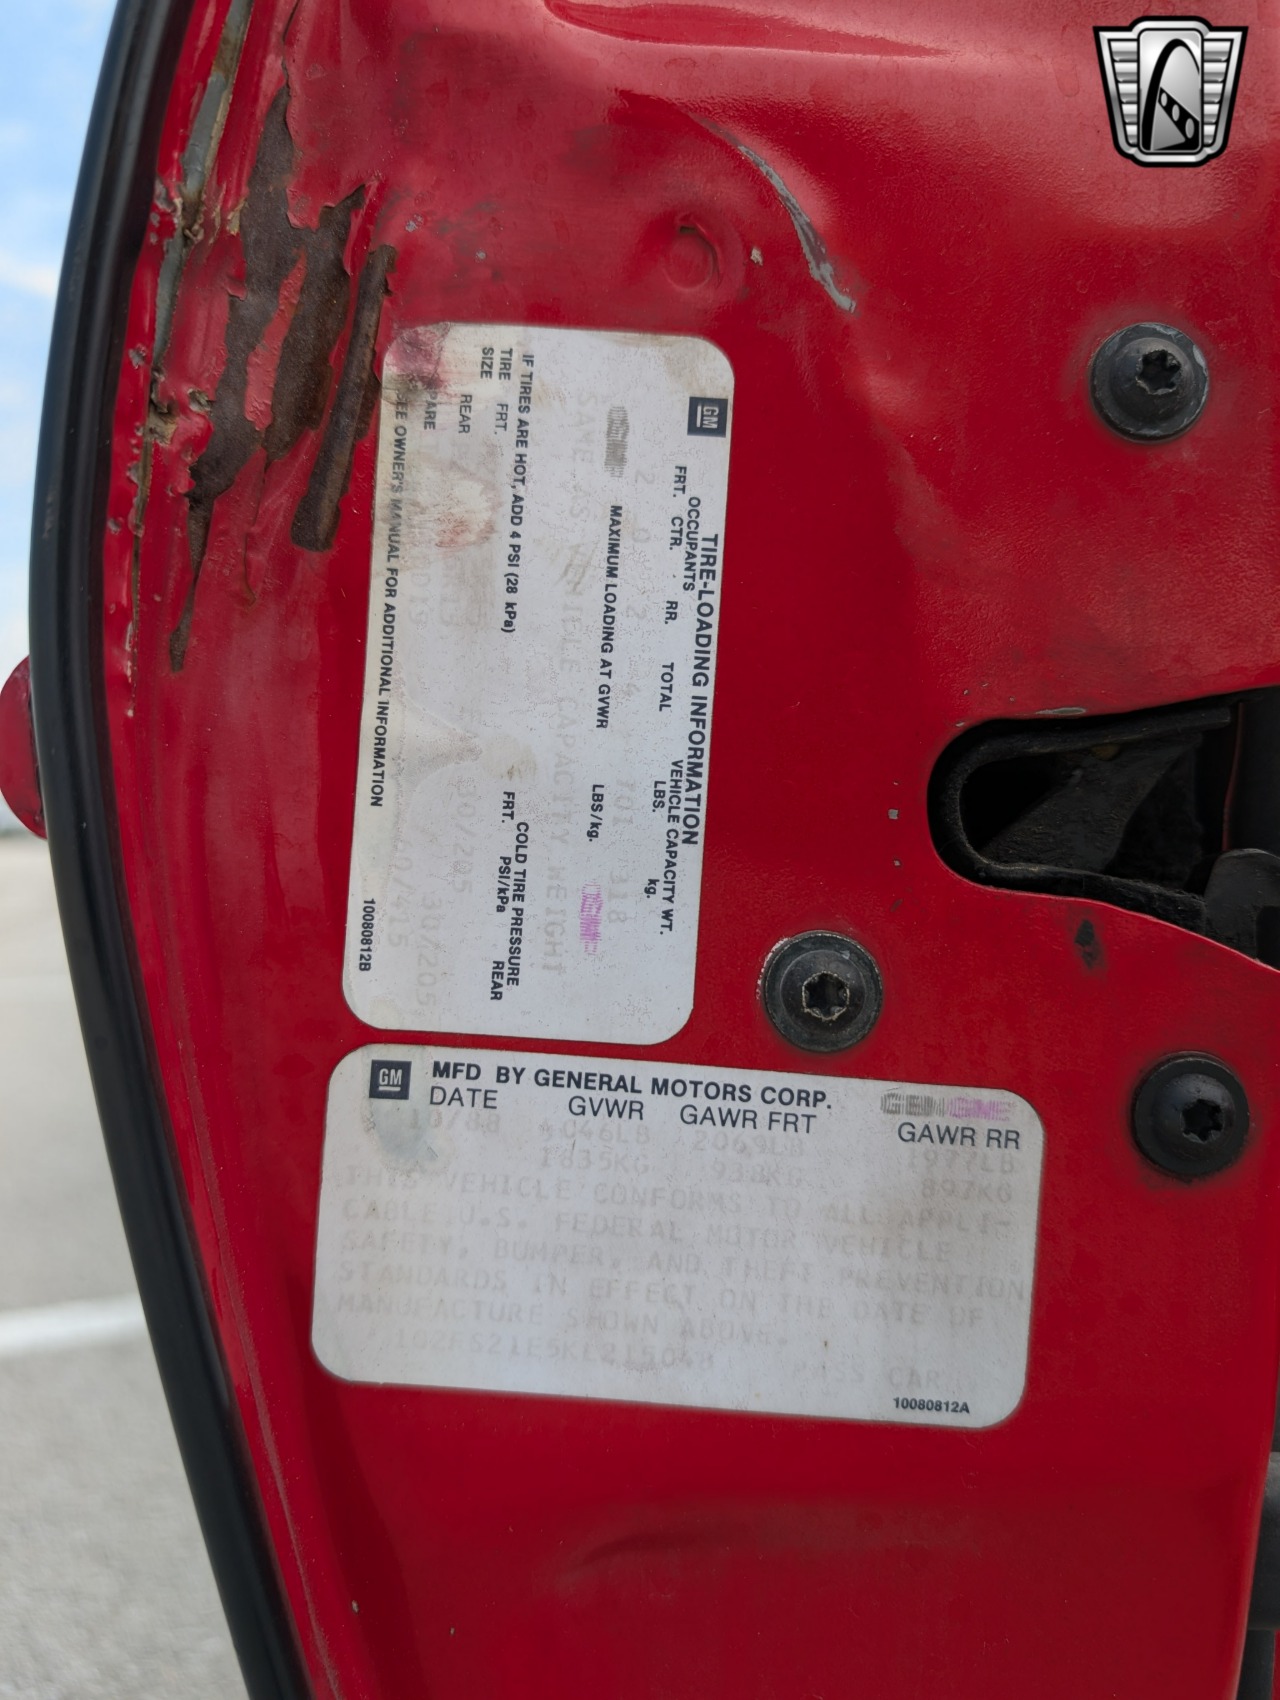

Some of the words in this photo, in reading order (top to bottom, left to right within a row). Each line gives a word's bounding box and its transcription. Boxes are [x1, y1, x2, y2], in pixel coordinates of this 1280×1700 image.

[480, 347, 494, 378] SIZE
[499, 348, 513, 380] TIRE
[522, 354, 534, 367] IF
[518, 372, 532, 413] TIRES
[459, 394, 472, 433] REAR
[495, 403, 508, 434] FRT.
[516, 418, 529, 448] ARE
[391, 426, 407, 493] OWNER'S
[511, 454, 527, 489] HOT,
[673, 466, 687, 497] FRT.
[511, 494, 524, 526] ADD
[510, 531, 521, 539] 4
[606, 506, 622, 578] MAXIMUM
[670, 517, 683, 550] CTR.
[682, 497, 702, 592] OCCUPANTS
[508, 544, 521, 567] PSI
[385, 568, 398, 597] FOR
[504, 573, 519, 593] (28
[501, 602, 517, 633] kPa)
[601, 584, 617, 653] LOADING
[665, 601, 678, 624] RR.
[690, 534, 718, 688] TIRE-LOADING
[379, 603, 396, 695] ADDITIONAL
[600, 659, 612, 679] AT
[659, 662, 674, 711] TOTAL
[596, 684, 610, 728] GVWR
[371, 701, 389, 806] INFORMATION
[550, 696, 577, 845] CAPACITY
[681, 696, 707, 846] INFORMATION
[502, 792, 515, 823] FRT.
[652, 781, 666, 812] LBS.
[668, 760, 684, 824] VEHICLE
[587, 785, 604, 841] LBS/kg.
[515, 822, 529, 863] COLD
[496, 856, 511, 912] PSI/kPa
[512, 869, 526, 902] TIRE
[663, 829, 679, 903] CAPACITY
[644, 879, 659, 898] kg.
[359, 899, 375, 971] 10080812B
[542, 865, 566, 975] WEIGHT
[660, 909, 673, 935] WT.
[507, 908, 523, 986] PRESSURE
[491, 961, 504, 1000] REAR
[433, 1061, 481, 1080] MFD
[496, 1066, 526, 1084] BY
[534, 1069, 642, 1094] GENERAL
[651, 1078, 751, 1102] MOTORS
[761, 1087, 831, 1109] CORP.
[430, 1086, 497, 1109] DATE
[569, 1096, 643, 1120] GVWR
[680, 1105, 757, 1129] GAWR
[768, 1111, 816, 1133] FRT
[898, 1122, 976, 1146] GAWR
[987, 1129, 1020, 1149] RR
[446, 1171, 573, 1201] VEHICLE
[894, 1397, 970, 1414] 10080812A
